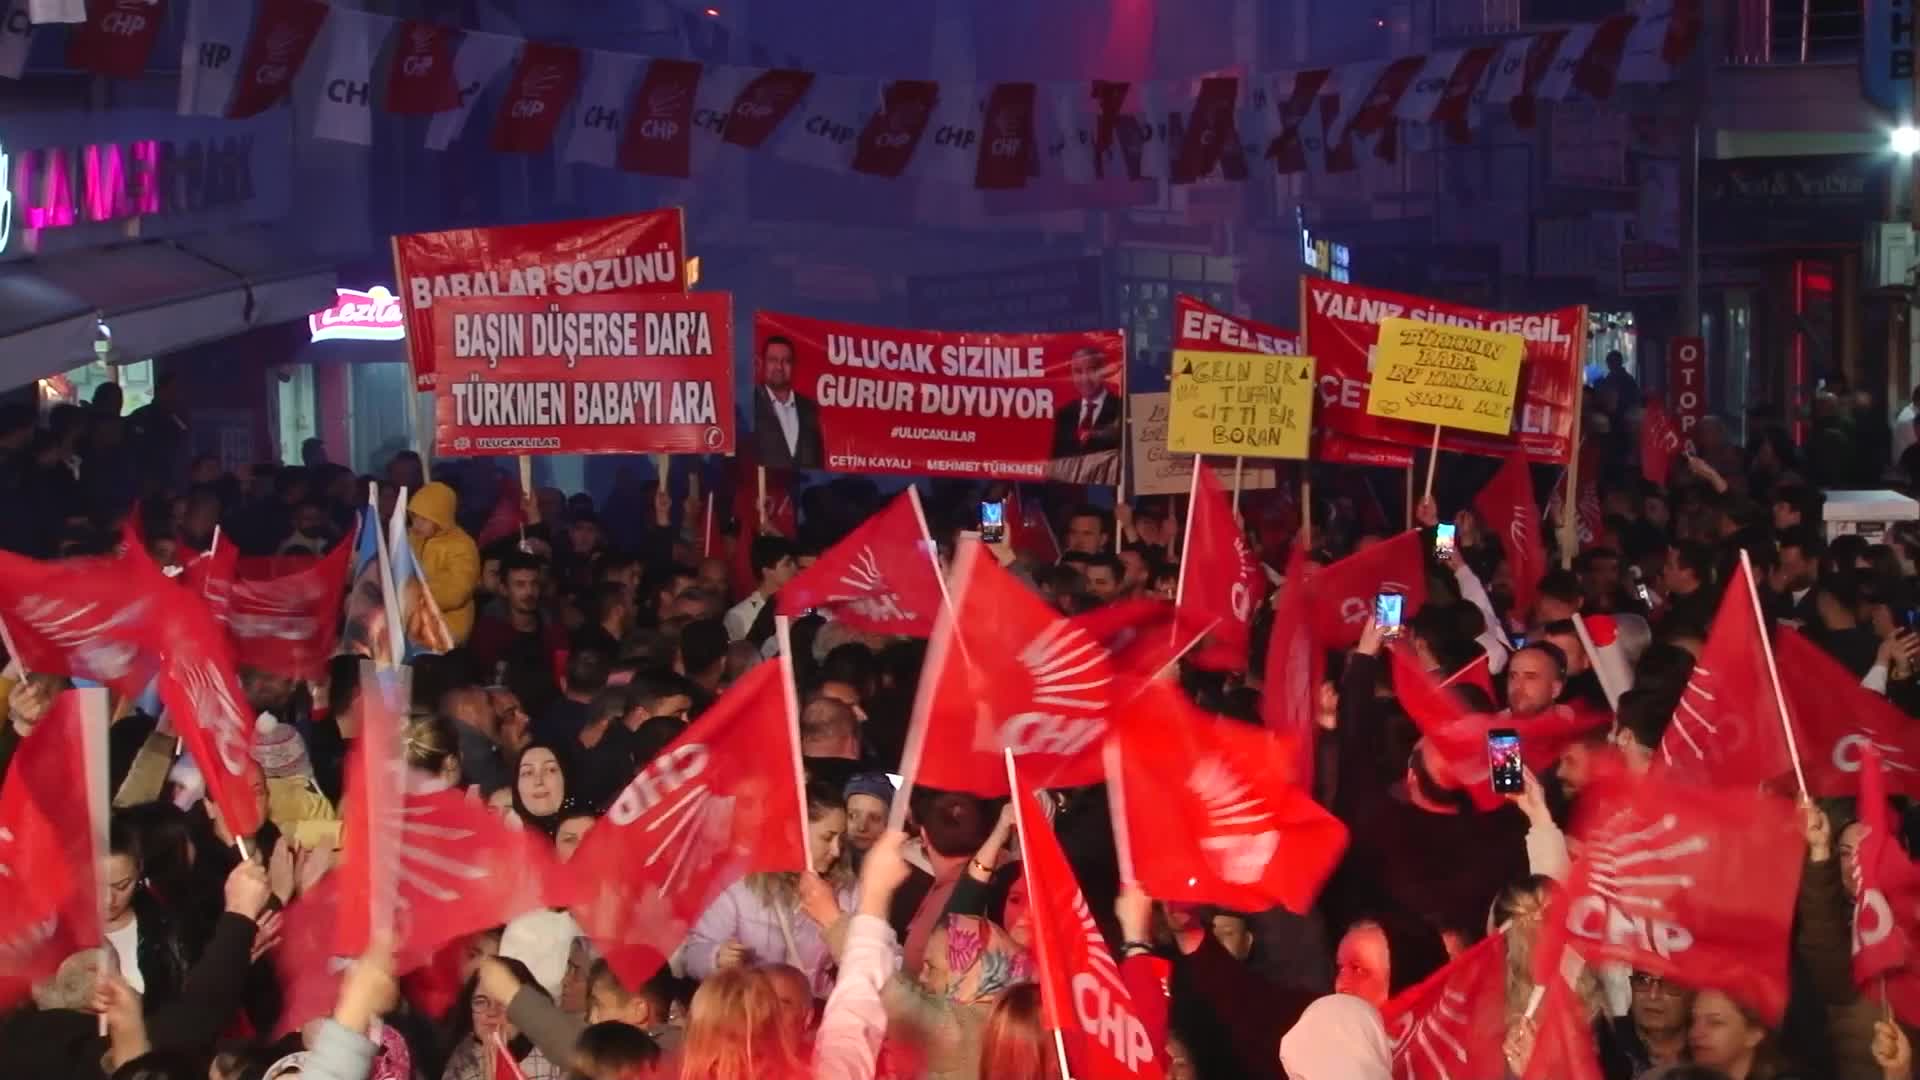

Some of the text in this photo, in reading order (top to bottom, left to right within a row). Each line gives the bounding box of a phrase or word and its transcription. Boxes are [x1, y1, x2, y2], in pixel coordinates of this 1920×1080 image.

[102, 11, 146, 36] CHP
[199, 41, 232, 69] HP
[327, 78, 370, 107] CH
[510, 98, 546, 120] CHP
[692, 107, 728, 136] CH
[640, 118, 679, 143] CHP
[411, 243, 677, 309] BABALAR SÖZÜNÜ
[454, 304, 713, 368] BAŞIN DÜŞERSE DAR'A
[826, 334, 1045, 379] ULUCAK SİZİNLE
[452, 373, 717, 426] TÜRKMEN BABA'YI ARA
[816, 374, 1054, 419] GURUR DUYUYOR
[1320, 375, 1371, 408] ÇE
[891, 426, 976, 442] #ULUCAKLILAR
[1213, 425, 1282, 447] BORAN
[829, 453, 911, 470] ÇETİN KAYALI
[927, 459, 1043, 477] MEHMET TÜRKMEN
[1565, 894, 1694, 961] CHP
[1072, 972, 1155, 1074] CHP
